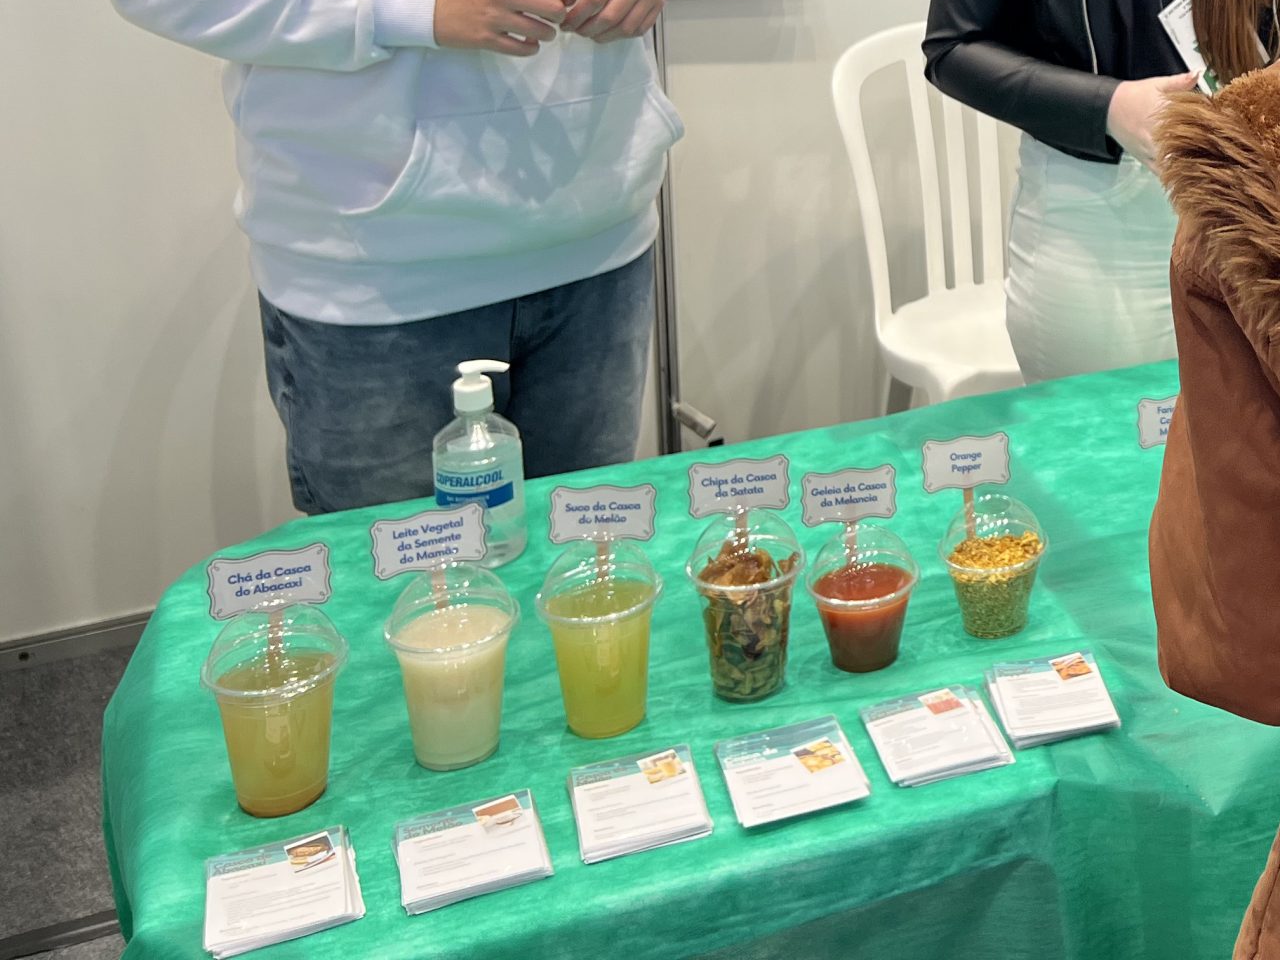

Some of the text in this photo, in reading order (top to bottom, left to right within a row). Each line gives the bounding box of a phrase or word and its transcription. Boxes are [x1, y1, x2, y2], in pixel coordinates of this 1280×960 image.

[950, 452, 982, 462] Orange
[952, 464, 982, 474] Pepper
[702, 474, 776, 488] Chips da Casca
[715, 488, 728, 497] da
[811, 482, 887, 496] Geleia da Casca
[565, 502, 640, 512] Suco da Casca
[820, 494, 878, 507] da Melancia
[578, 515, 592, 524] do
[393, 517, 464, 539] Leite Vegetal
[398, 534, 462, 552] da Semente
[400, 547, 459, 564] do Mamão
[228, 565, 312, 584] Chá da Casca
[235, 578, 302, 596] do Abacaxi
